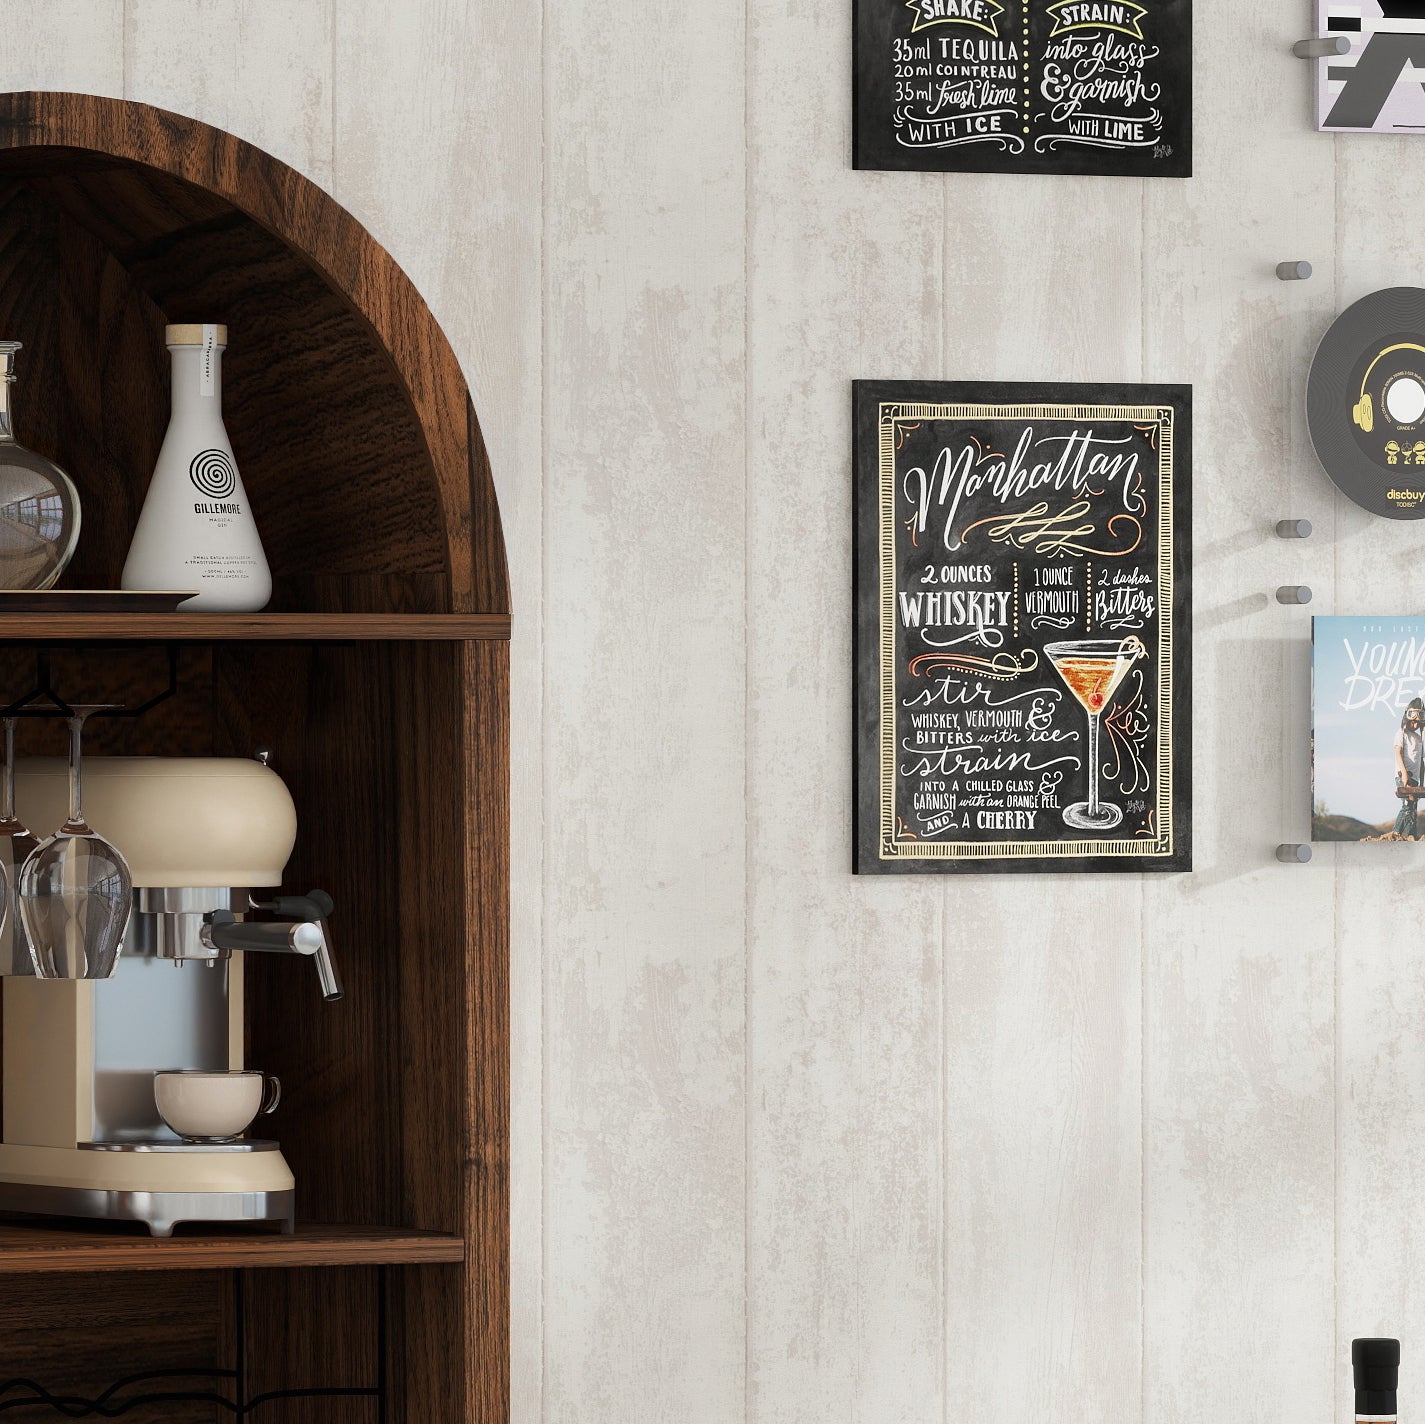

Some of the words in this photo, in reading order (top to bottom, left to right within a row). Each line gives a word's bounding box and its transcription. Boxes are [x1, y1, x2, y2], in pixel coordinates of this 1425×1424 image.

[921, 0, 988, 21] SHAKE:
[1061, 3, 1131, 26] STRAIN:
[938, 38, 1018, 63] TEQUILA
[1040, 33, 1094, 61] into
[1082, 33, 1160, 76] glass
[936, 64, 1016, 79] COINTREAU
[927, 80, 980, 114] fresh
[979, 80, 1017, 109] lime
[1040, 62, 1071, 102] &
[1060, 71, 1161, 116] garnish
[908, 122, 956, 141] WITH
[966, 115, 1001, 133] ICE
[1068, 119, 1099, 136] WITH
[1105, 119, 1144, 141] LIME
[904, 426, 1142, 551] Manhattan
[194, 503, 242, 514] GILLEMORE
[921, 565, 938, 584] 2
[941, 565, 992, 583] OUNCES
[1034, 568, 1040, 586] 1
[1042, 567, 1073, 586] OUNCE
[1098, 569, 1110, 586] 2
[1113, 566, 1153, 585] dashes
[898, 590, 1013, 632] WHISKEY
[1025, 590, 1079, 614] VERMOUTH
[1095, 587, 1155, 622] Bitters
[902, 675, 1038, 707] stir
[911, 712, 961, 731] WHISKEY,
[965, 710, 1022, 728] VERMOUTH
[1025, 698, 1055, 730] &
[916, 731, 973, 744] BITTERS
[977, 729, 1021, 743] with
[1026, 728, 1079, 743] ice
[900, 745, 1061, 777] strain
[920, 781, 946, 792] INTO
[952, 781, 959, 791] A
[966, 780, 1003, 792] CHILLED
[1005, 780, 1034, 792] GLASS
[1038, 771, 1063, 796] &
[913, 792, 956, 810] GARNISH
[958, 795, 986, 807] with
[986, 796, 1004, 807] an
[1006, 795, 1039, 809] ORANGE
[1041, 795, 1061, 809] PEEL
[927, 815, 950, 832] AND
[962, 812, 970, 828] A
[976, 810, 1037, 830] CHERRY
